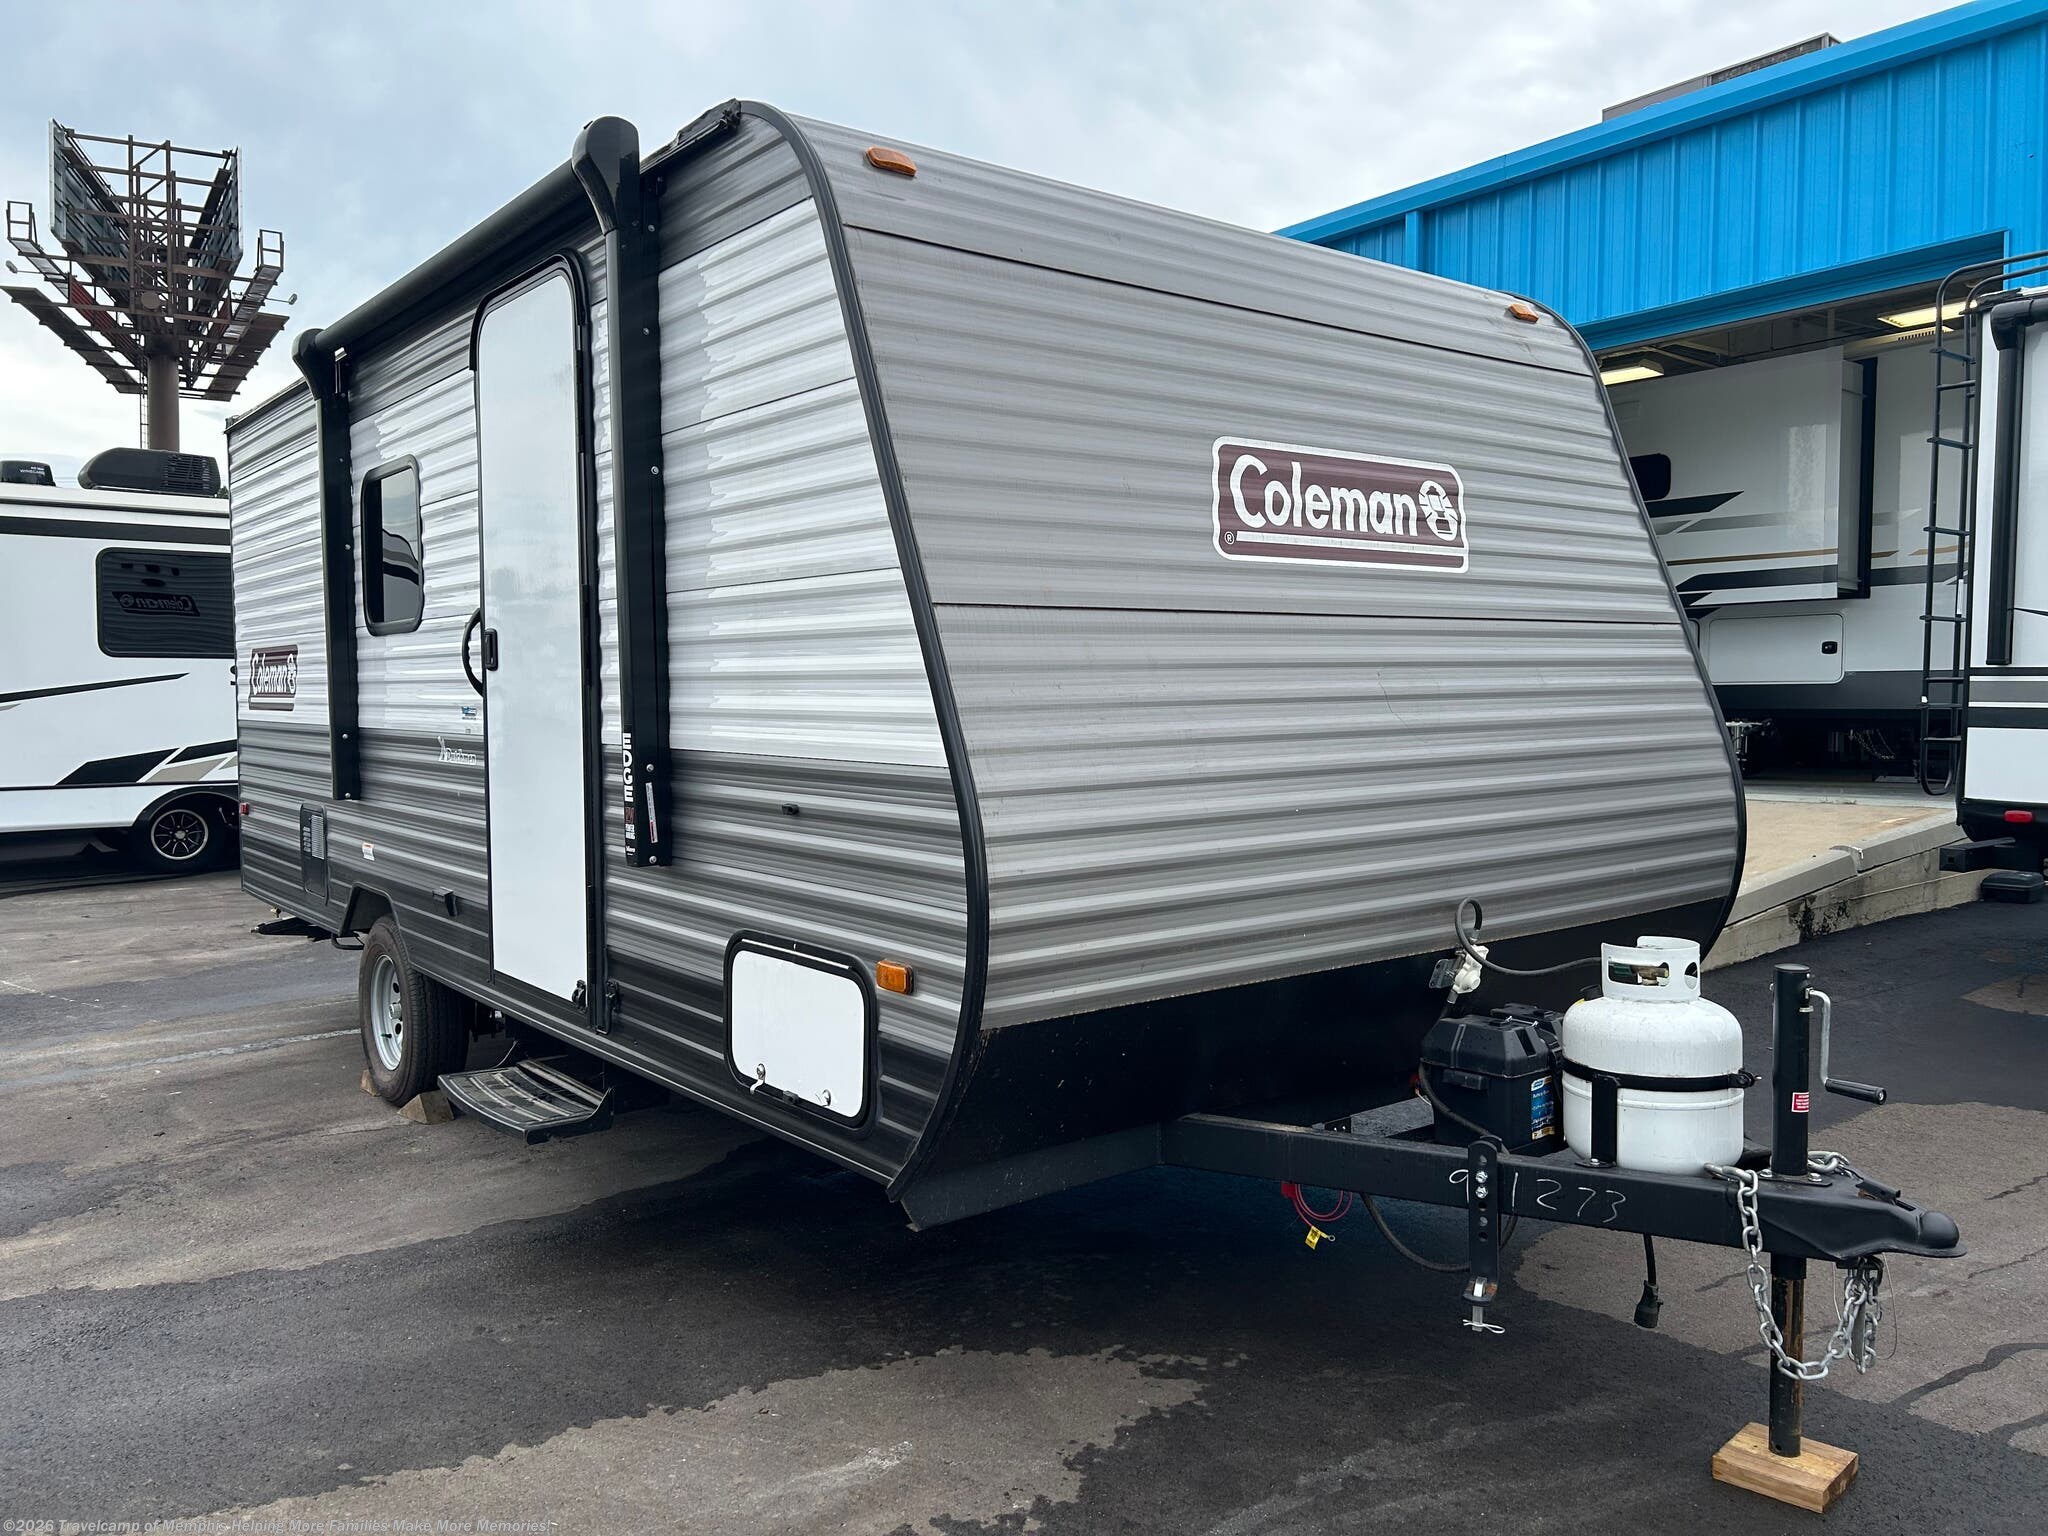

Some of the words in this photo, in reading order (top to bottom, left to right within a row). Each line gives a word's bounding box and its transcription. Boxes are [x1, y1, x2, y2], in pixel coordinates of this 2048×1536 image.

[1230, 454, 1418, 537] Coleman
[251, 652, 288, 696] Coleman
[622, 732, 634, 802] EDGE
